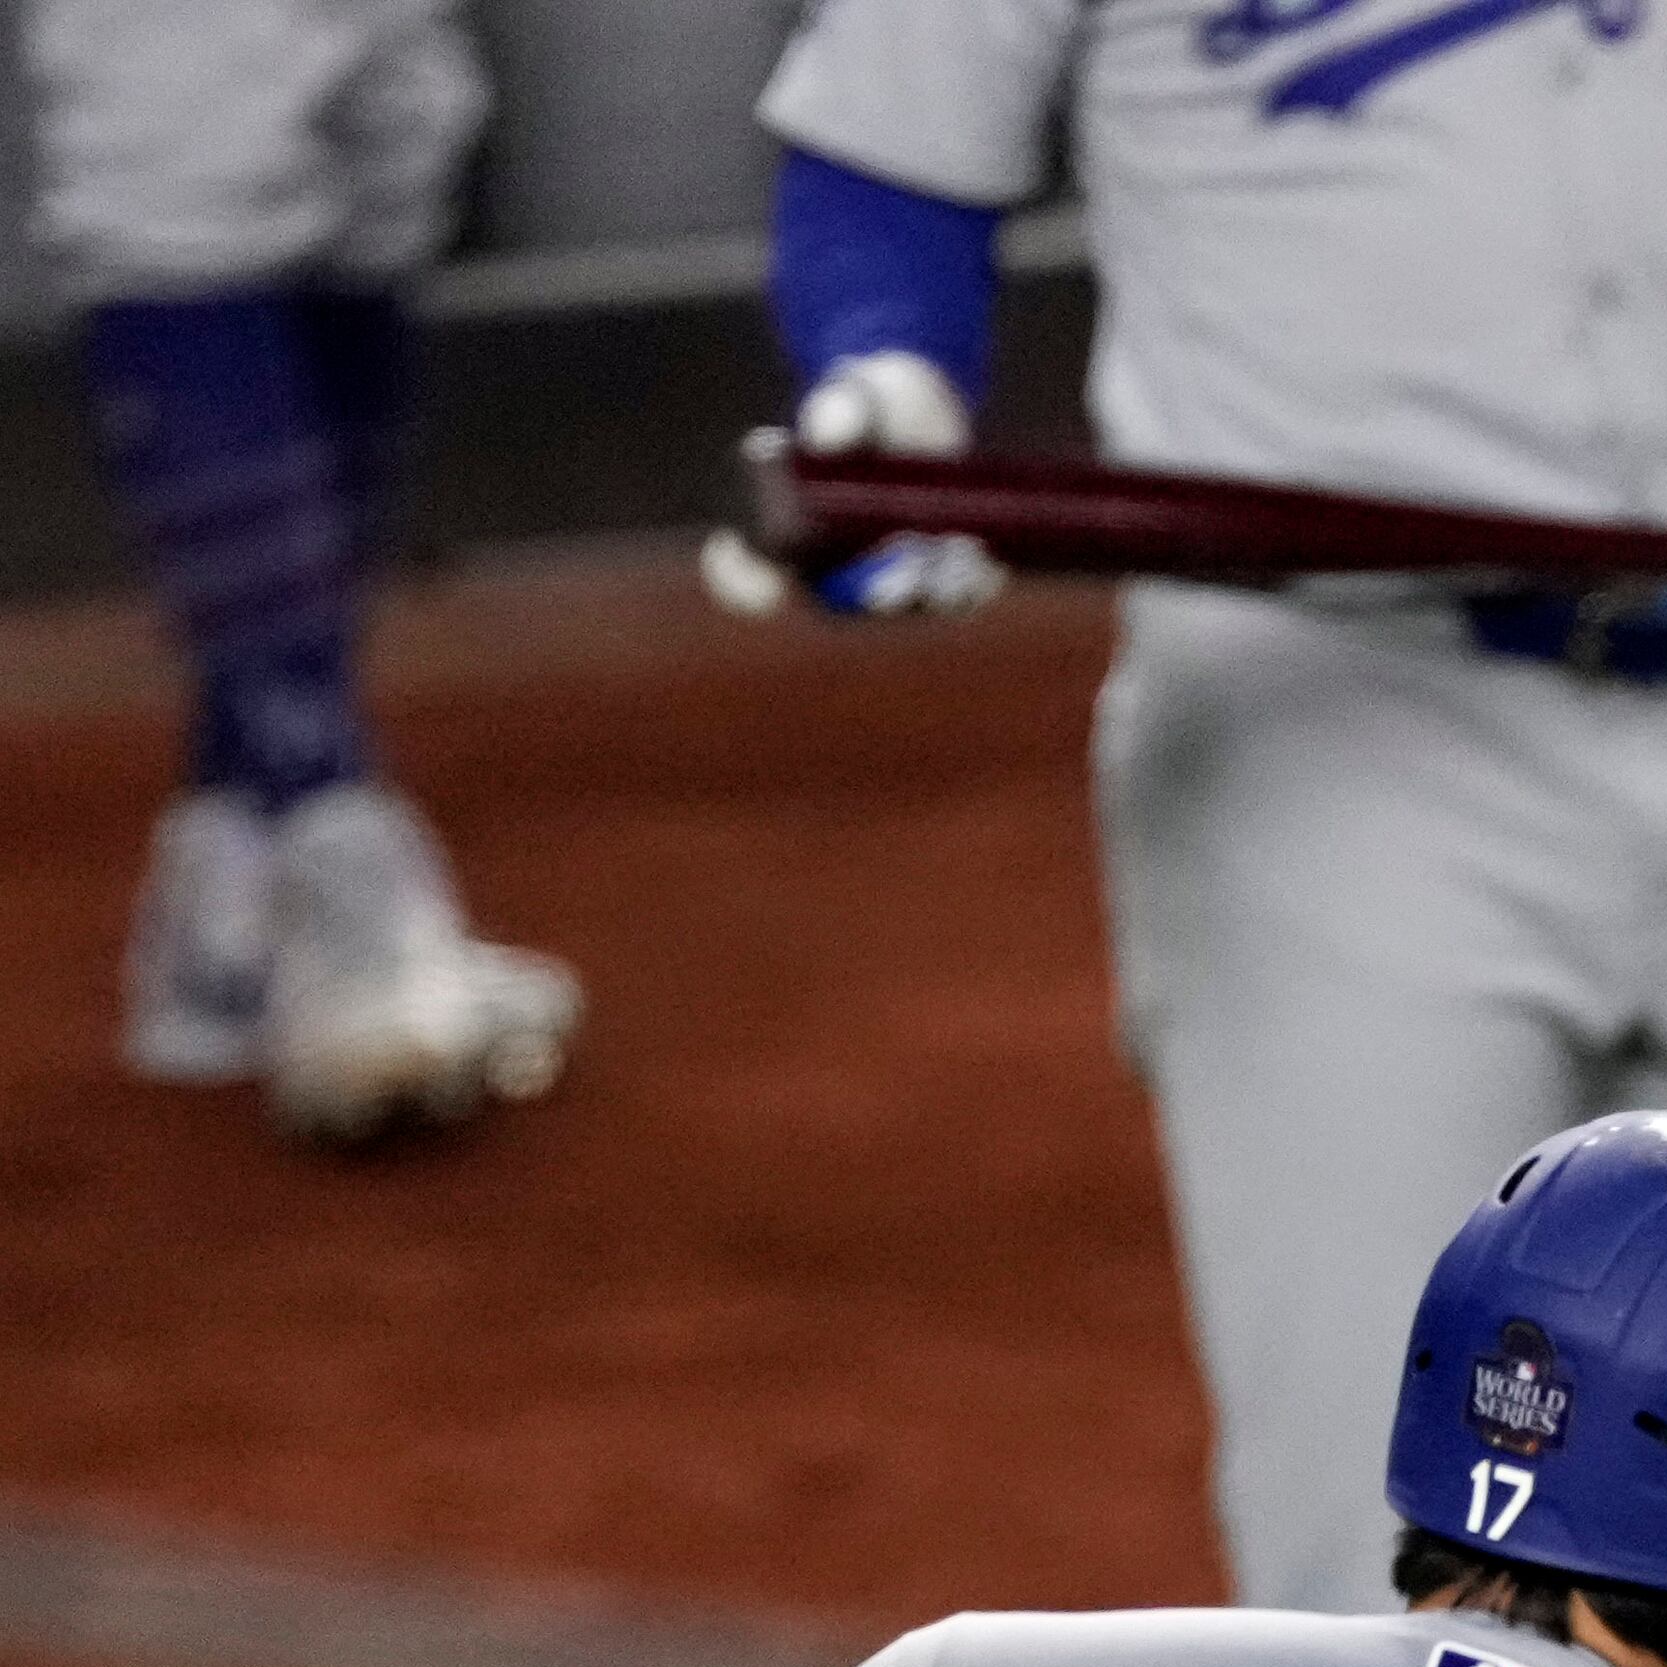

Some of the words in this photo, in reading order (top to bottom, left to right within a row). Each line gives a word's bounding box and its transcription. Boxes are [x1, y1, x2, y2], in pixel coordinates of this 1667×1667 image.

[1473, 1391, 1559, 1437] SERIES
[1475, 1364, 1567, 1416] WORLD
[1465, 1458, 1535, 1542] 17
